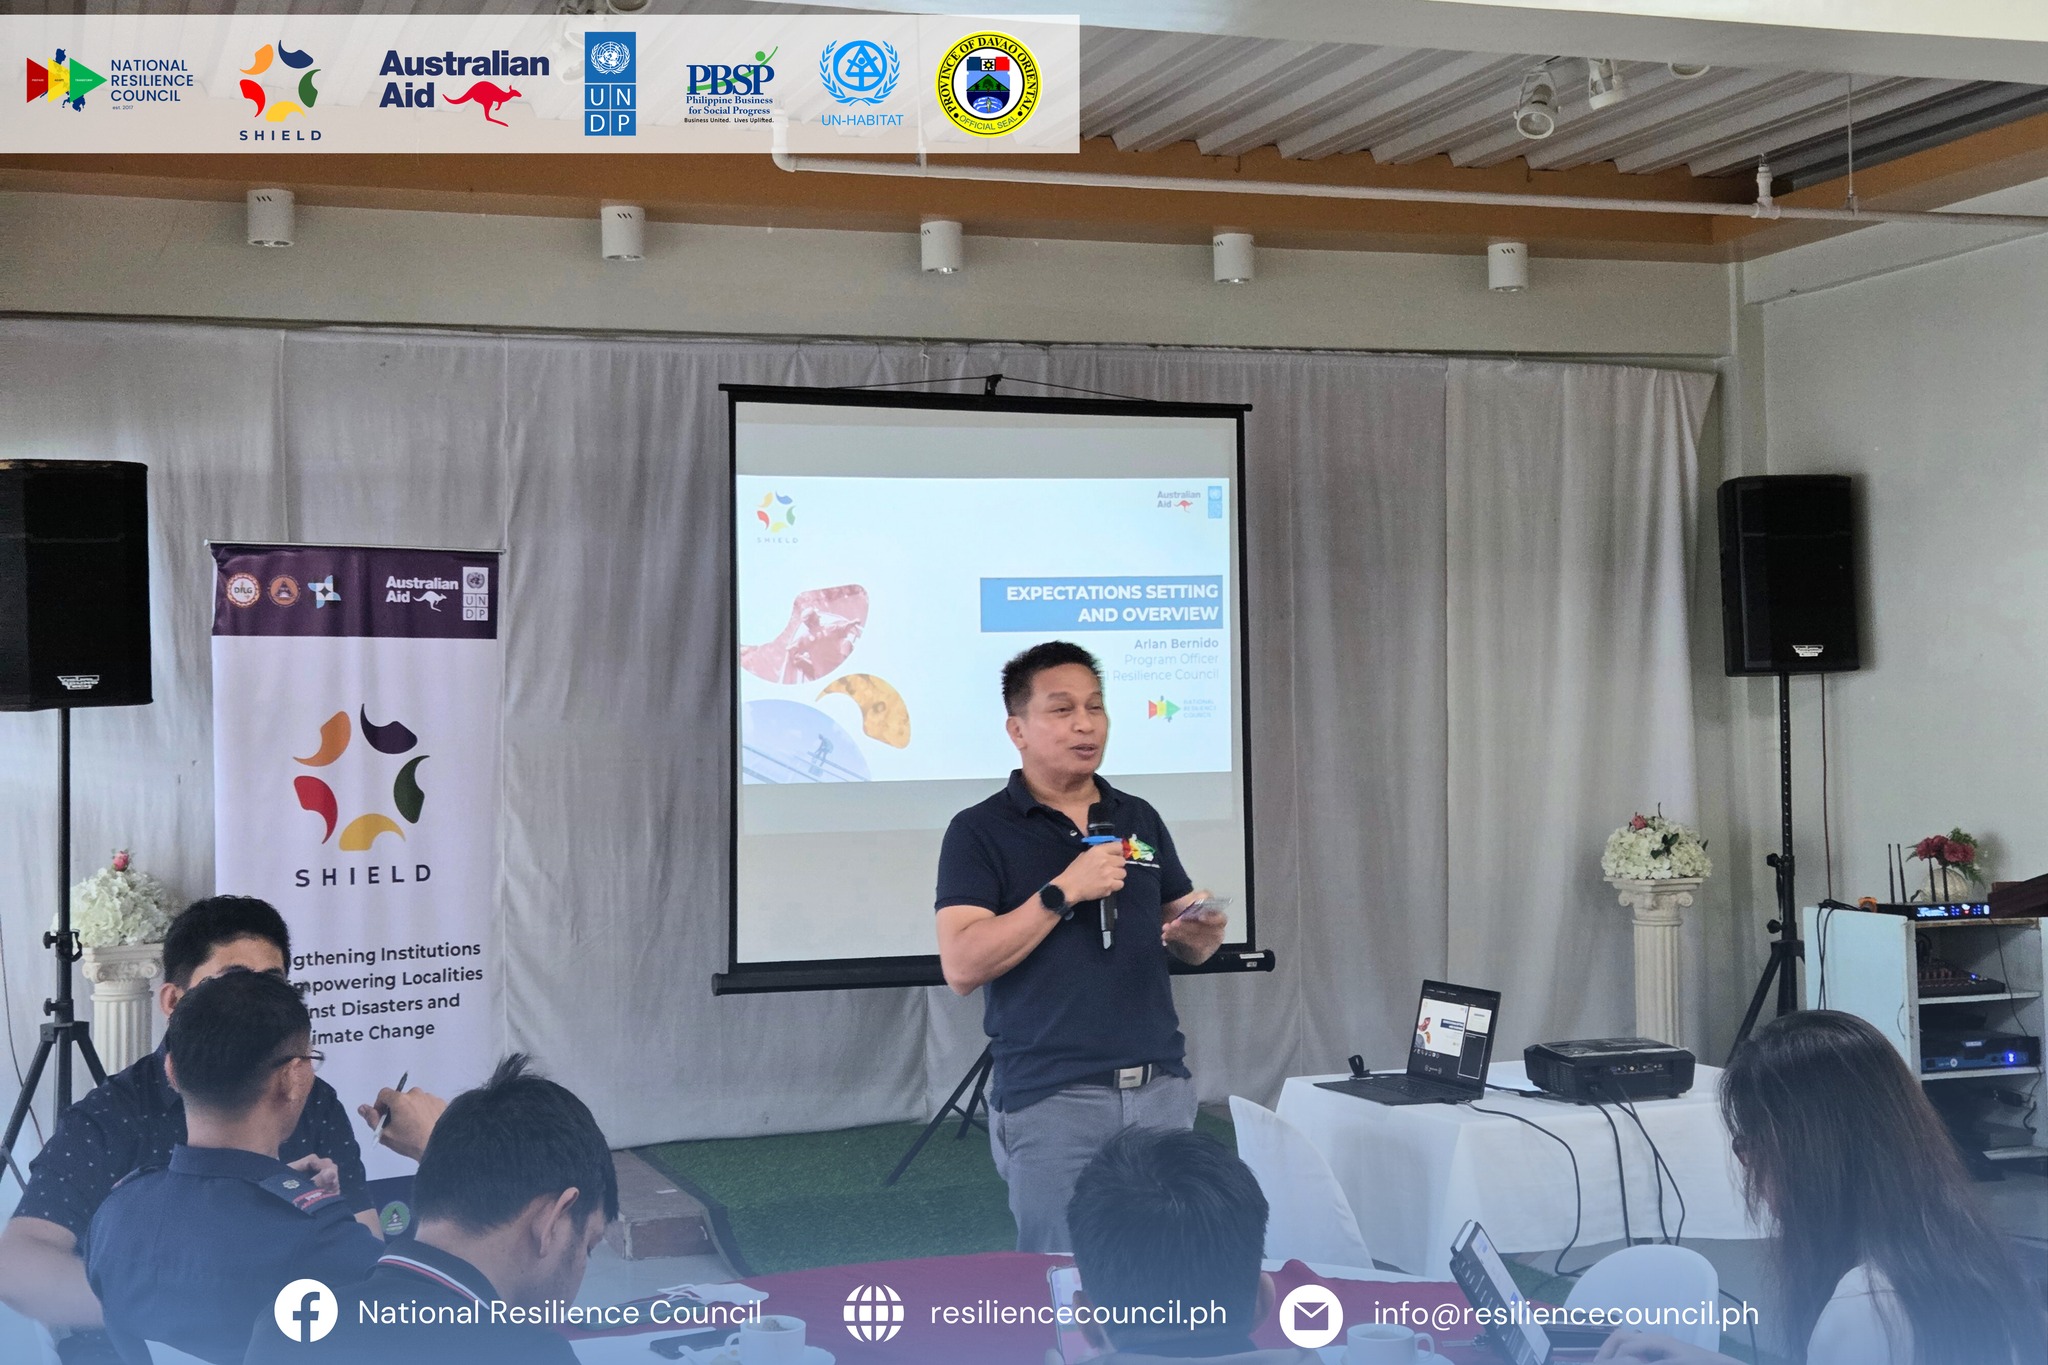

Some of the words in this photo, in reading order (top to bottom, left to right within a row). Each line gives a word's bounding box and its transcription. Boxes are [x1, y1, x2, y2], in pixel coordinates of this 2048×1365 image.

[1157, 491, 1201, 499] Australian
[1157, 500, 1172, 508] Aid
[386, 575, 459, 590] Australian
[385, 590, 410, 603] Aid
[1007, 585, 1143, 601] EXPECTATIONS
[1146, 584, 1218, 600] SETTING
[1078, 607, 1119, 622] AND
[1122, 606, 1219, 622] OVERVIEW
[1134, 638, 1167, 650] Arlan
[1171, 637, 1219, 649] Bernido
[1124, 654, 1177, 668] Program
[1180, 653, 1219, 664] Officer
[1113, 670, 1172, 681] Resilience
[1175, 668, 1219, 680] Council
[295, 864, 432, 888] SHIELD
[293, 948, 376, 970] gthening
[381, 942, 481, 962] Institutions
[290, 973, 396, 996] mpowering
[402, 966, 483, 986] Localities
[342, 999, 424, 1017] Disasters
[427, 993, 460, 1009] and
[311, 1029, 364, 1045] imate
[369, 1023, 435, 1040] Change
